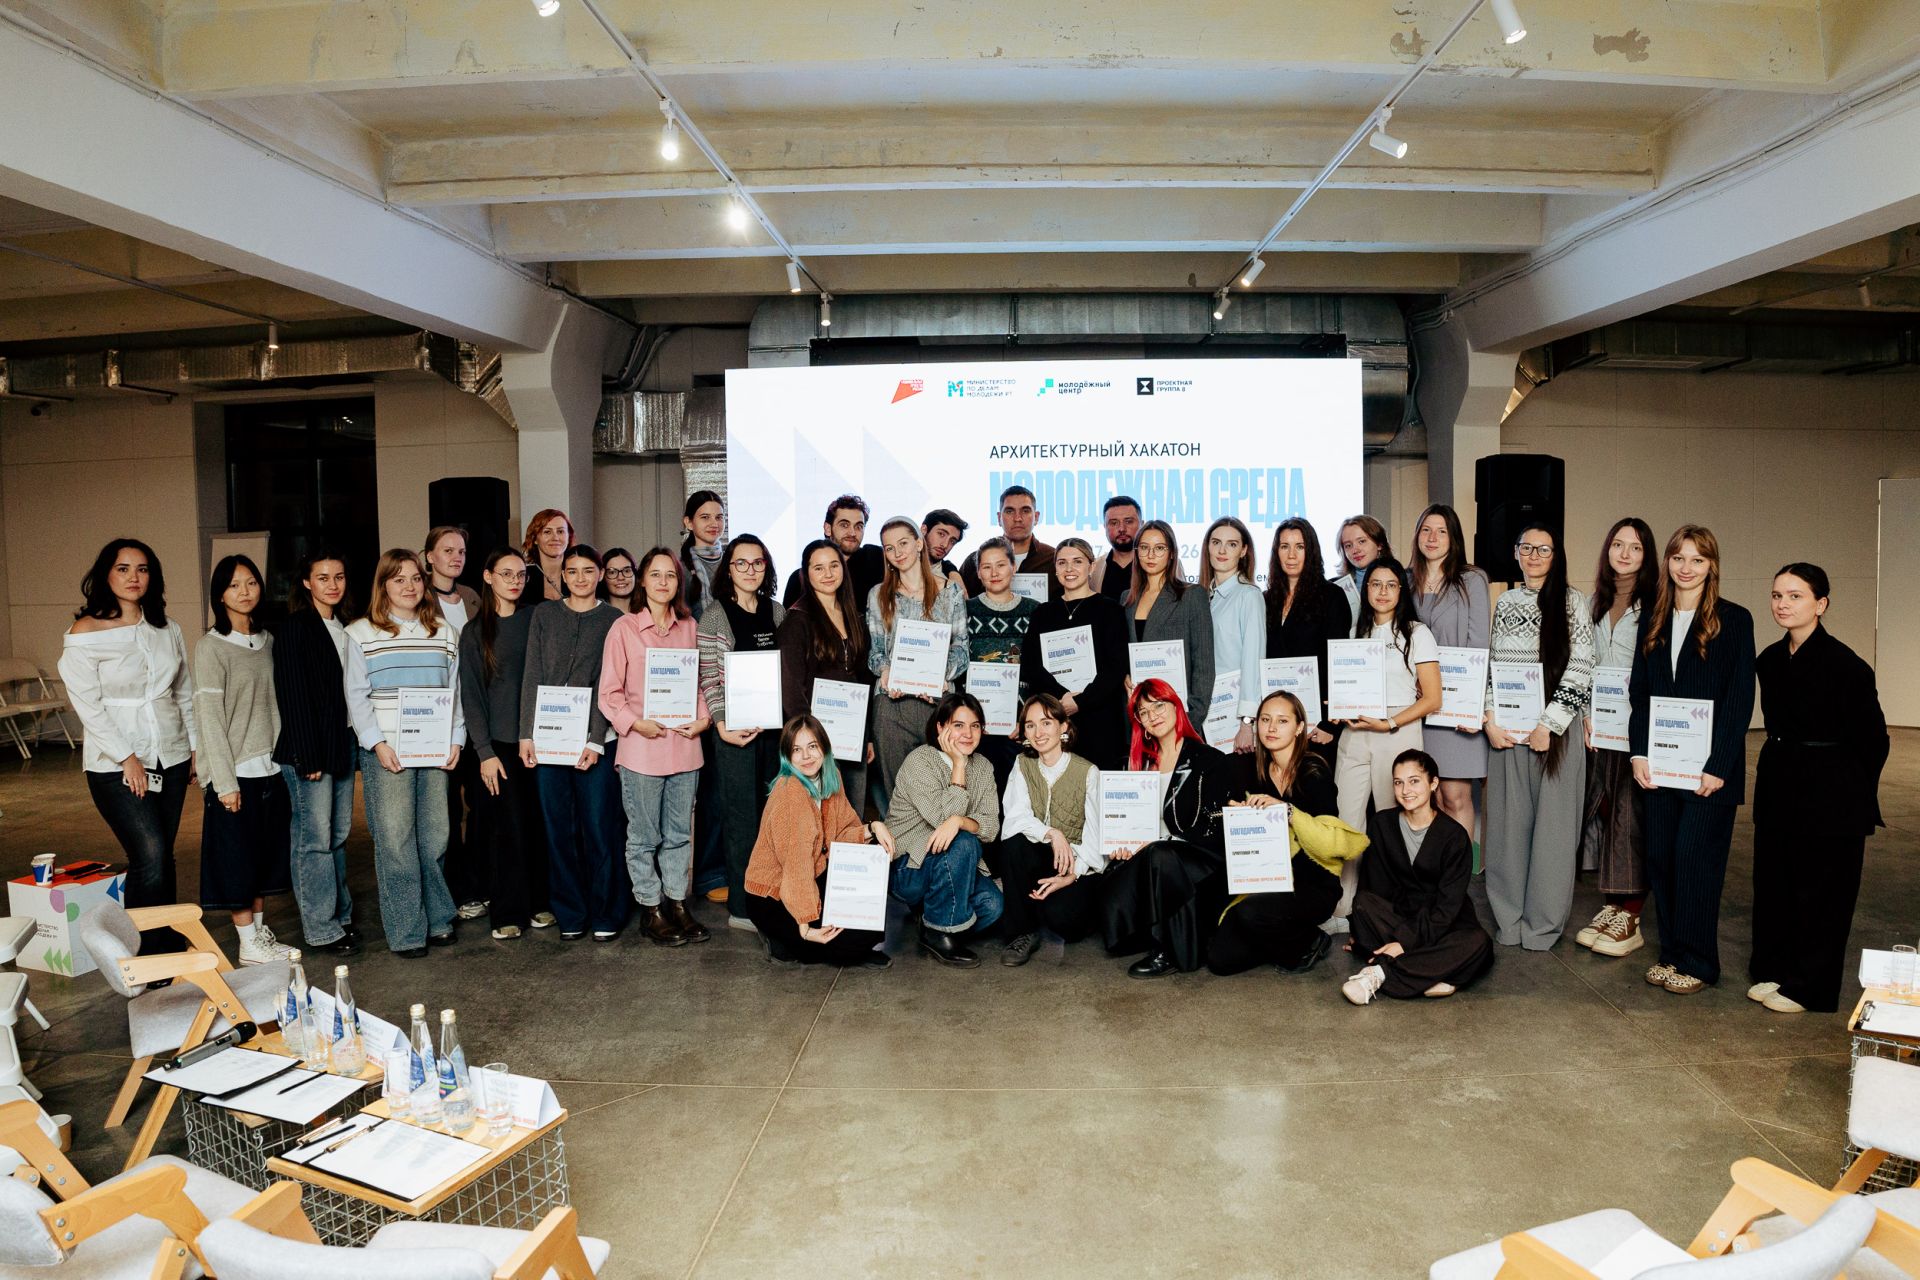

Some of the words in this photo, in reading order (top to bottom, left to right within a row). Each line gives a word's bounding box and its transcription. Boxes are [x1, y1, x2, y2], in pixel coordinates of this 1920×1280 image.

[1058, 379, 1111, 389] молодёжный
[1058, 387, 1082, 395] центр
[989, 440, 1125, 459] АРХИТЕКТУРНЫЙ
[1129, 442, 1201, 457] ХАКАТОН
[989, 469, 1204, 531] МЛОДЕЖНАЯ
[1209, 468, 1307, 529] СРЕДА
[1655, 718, 1690, 729] БЛАГОДАРНОСТЬ
